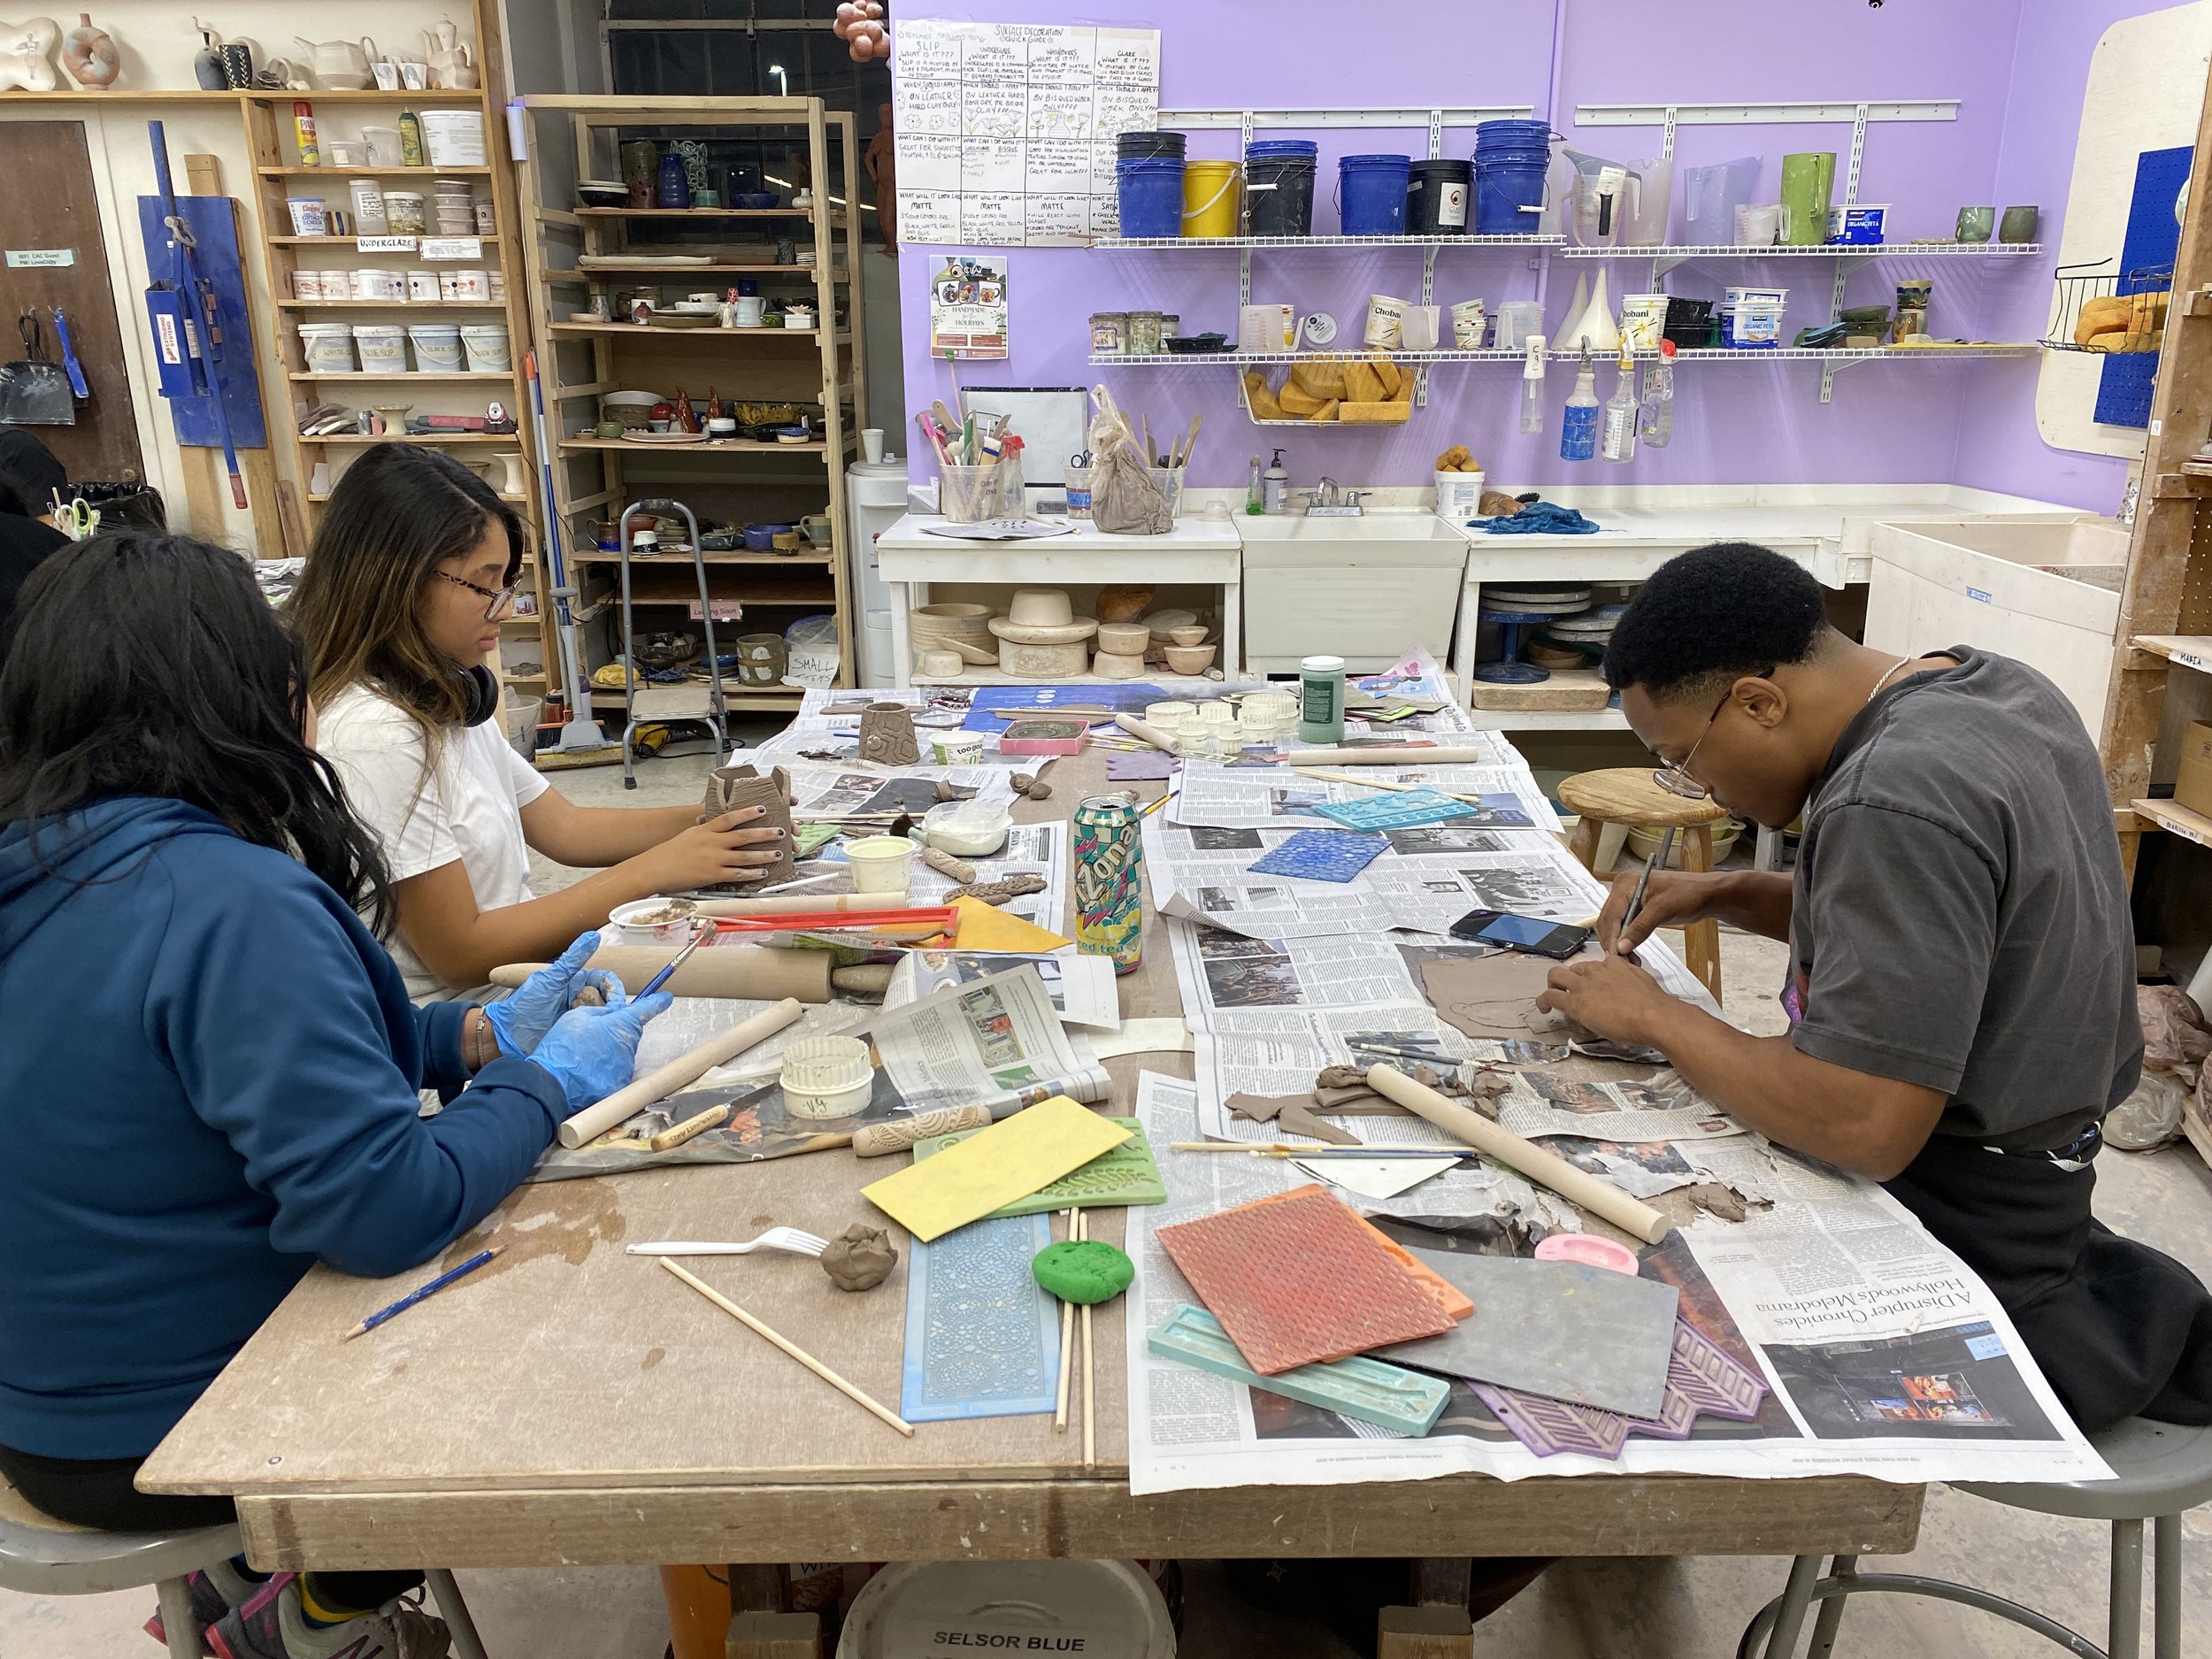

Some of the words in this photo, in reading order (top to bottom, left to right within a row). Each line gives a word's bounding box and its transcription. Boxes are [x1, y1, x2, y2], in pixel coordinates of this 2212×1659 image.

[917, 42, 940, 50] SLIP
[360, 239, 413, 248] UNDERGLAZE
[792, 658, 833, 672] SMALL
[1100, 942, 1124, 954] tea
[1755, 1292, 1856, 1311] Melodrama
[1955, 1291, 1971, 1305] A
[1870, 1294, 1955, 1318] Disrupter
[1774, 1310, 1868, 1330] Chronicles
[933, 1631, 1021, 1649] SELSOR
[1026, 1636, 1086, 1652] BLUE
